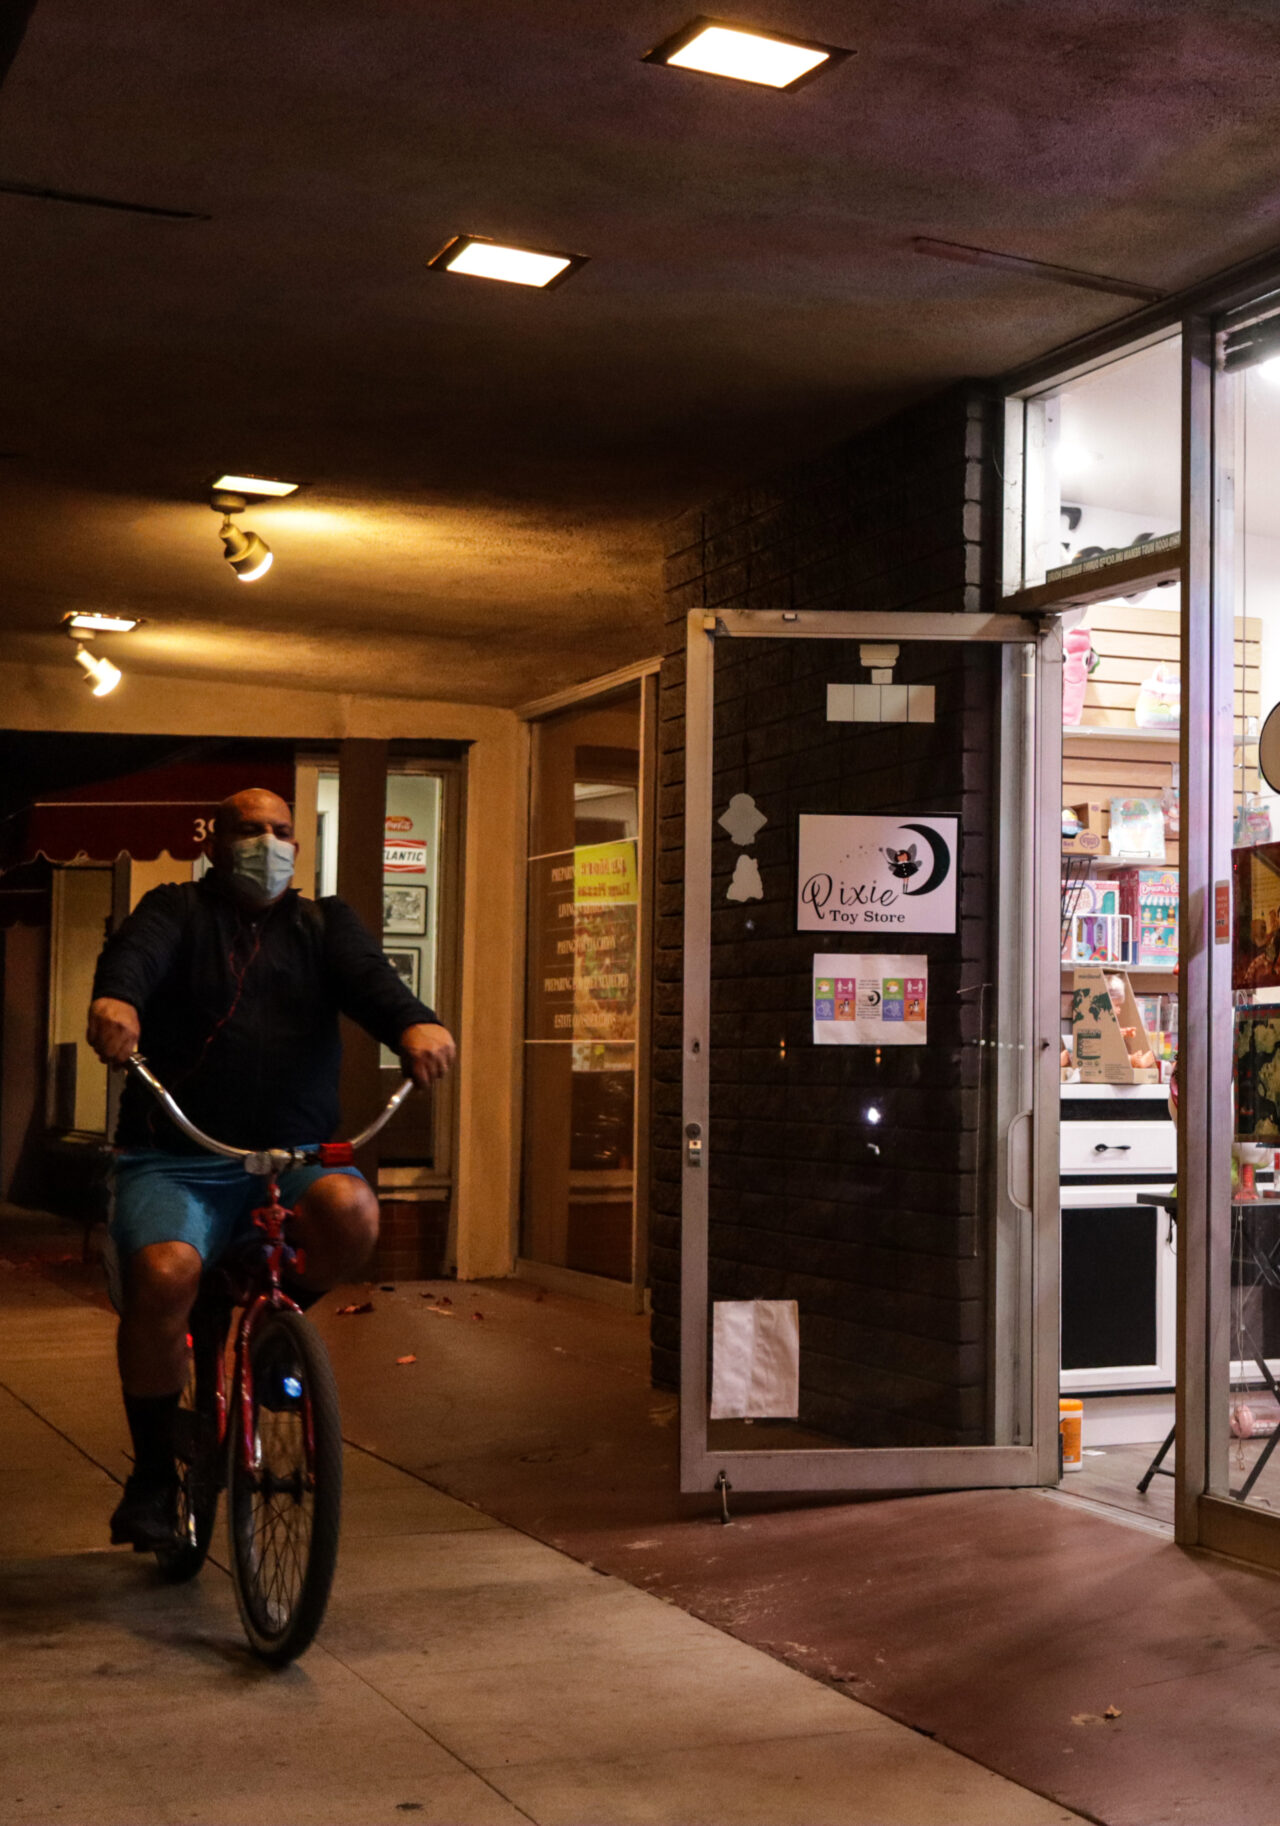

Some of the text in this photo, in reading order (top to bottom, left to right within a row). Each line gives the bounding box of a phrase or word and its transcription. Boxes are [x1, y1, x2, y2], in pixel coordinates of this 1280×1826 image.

[802, 872, 899, 919] Pixie
[829, 909, 906, 924] Toy Store
